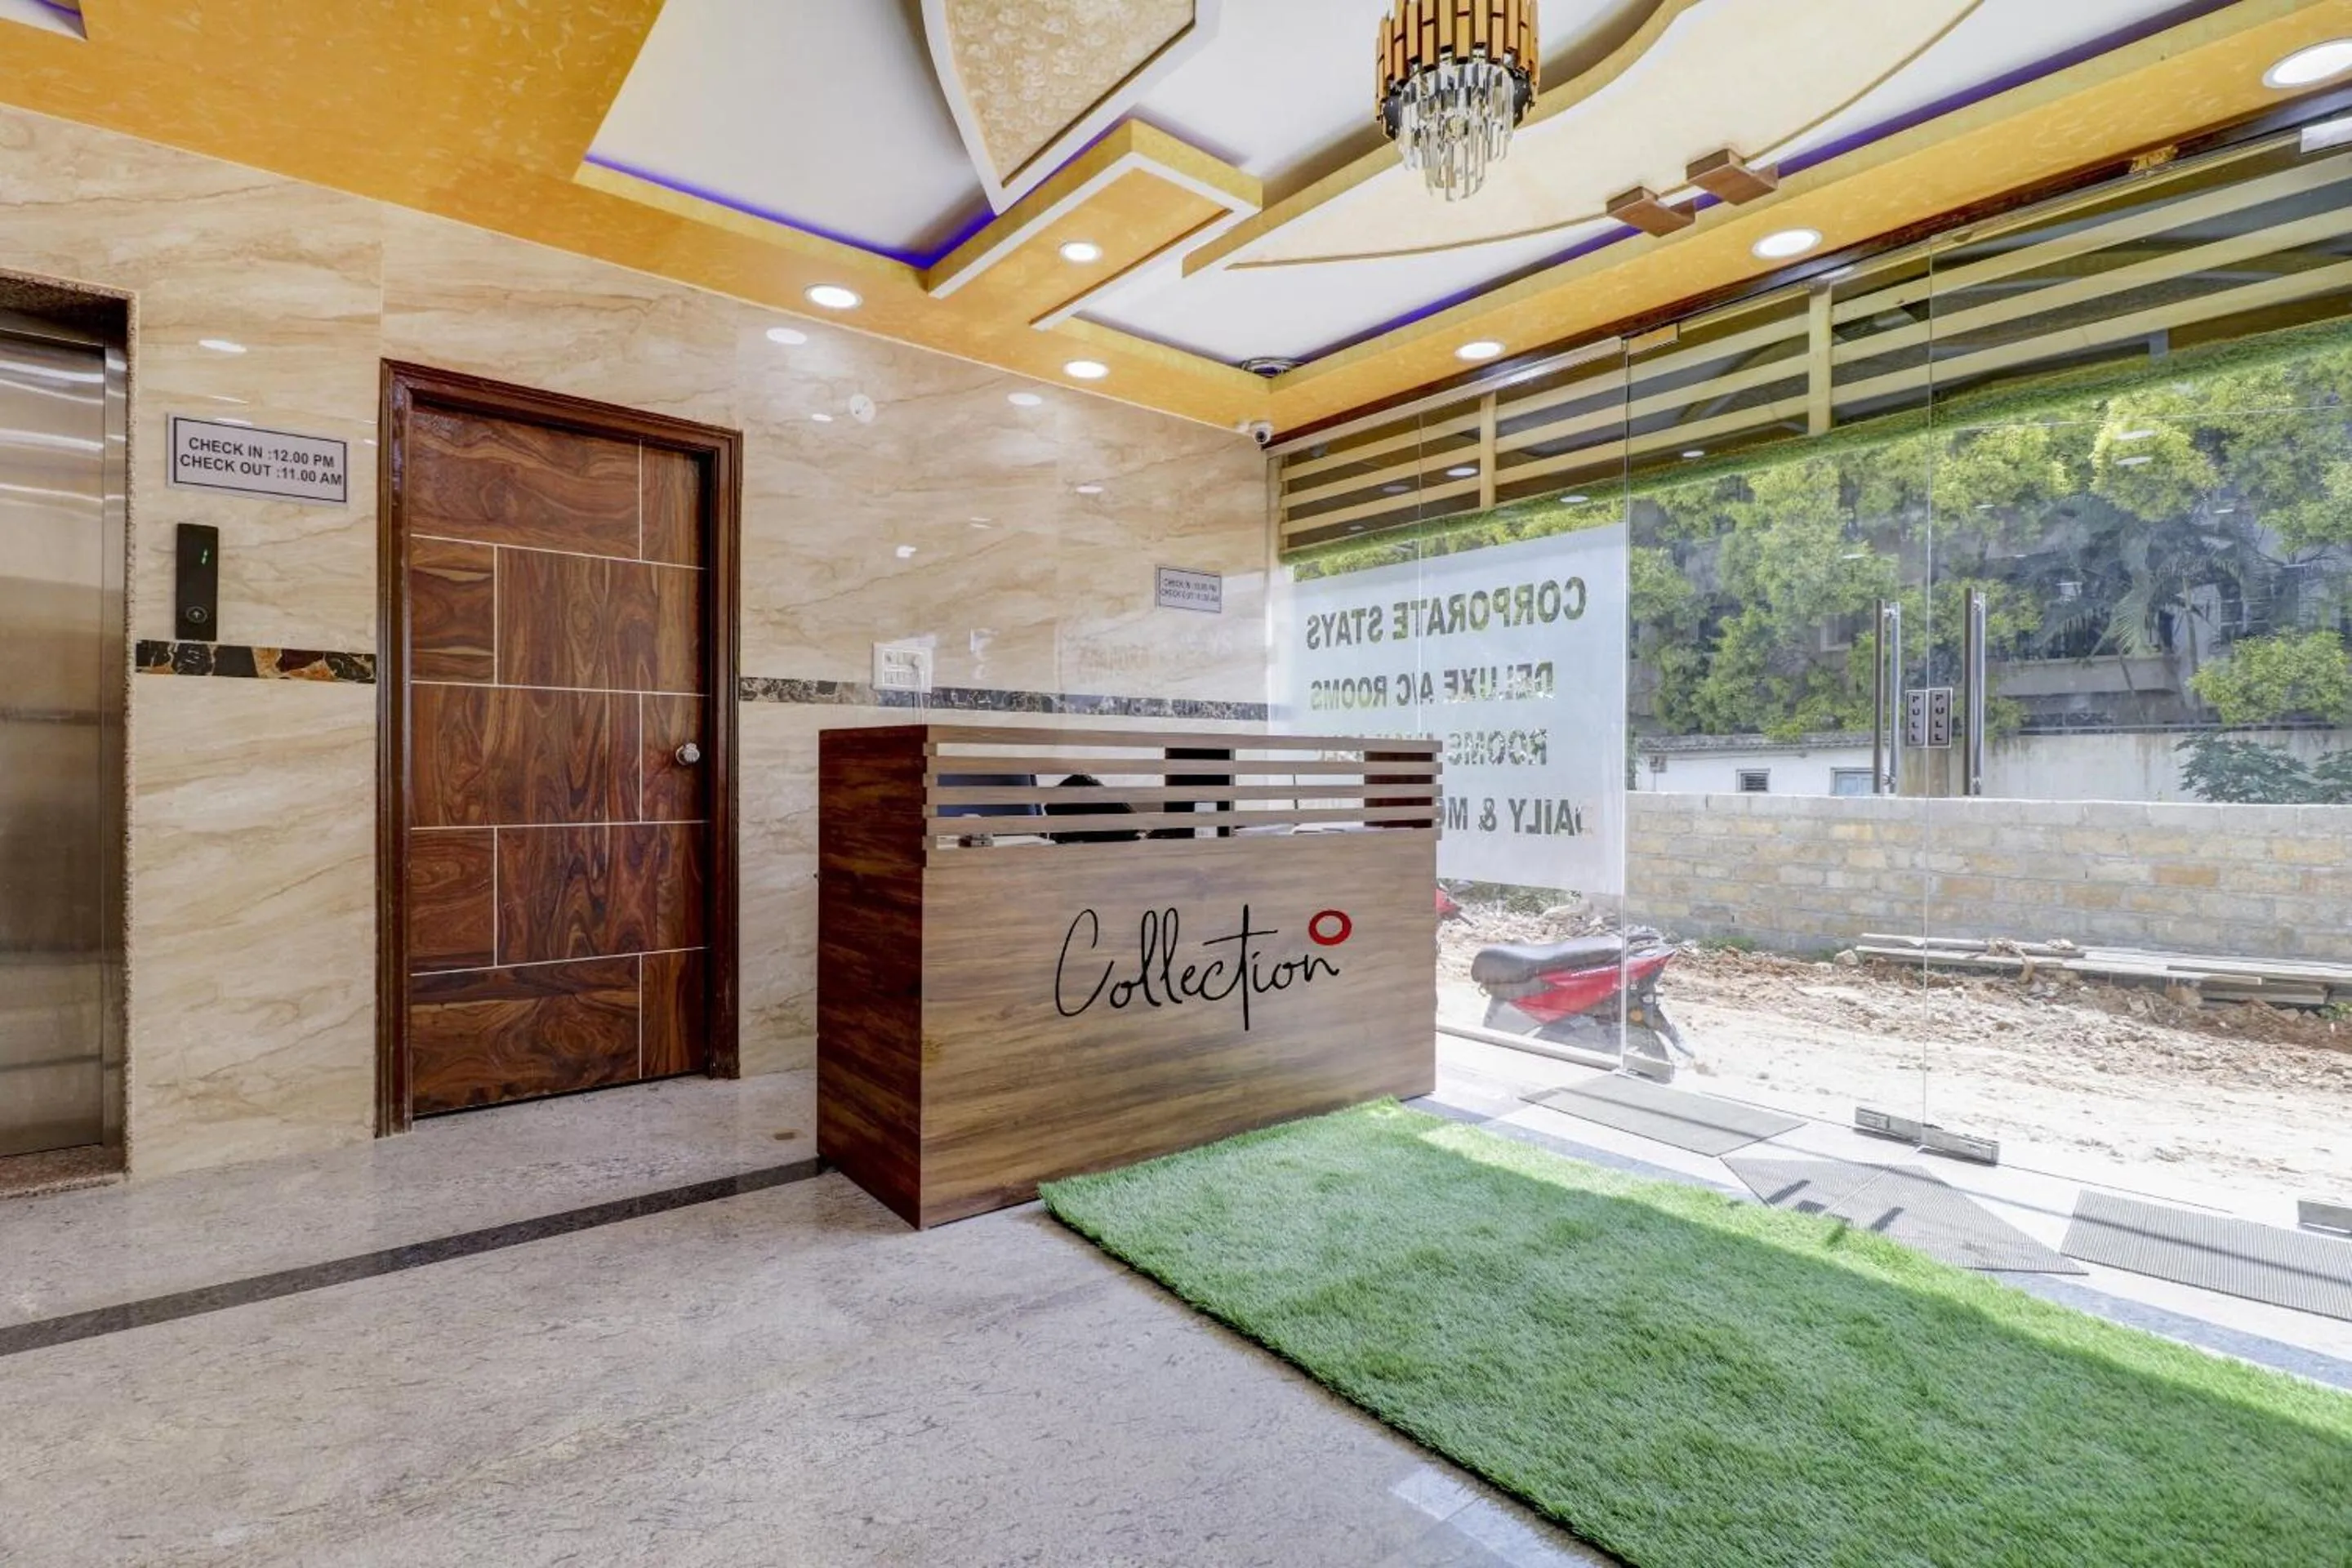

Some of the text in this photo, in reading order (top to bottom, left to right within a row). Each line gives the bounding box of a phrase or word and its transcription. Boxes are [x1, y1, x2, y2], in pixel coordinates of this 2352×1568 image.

[179, 453, 342, 486] CHECK OUT :11.00 AM
[188, 437, 336, 469] CHECK IN :12.00 PM
[1054, 903, 1340, 1031] Collection
